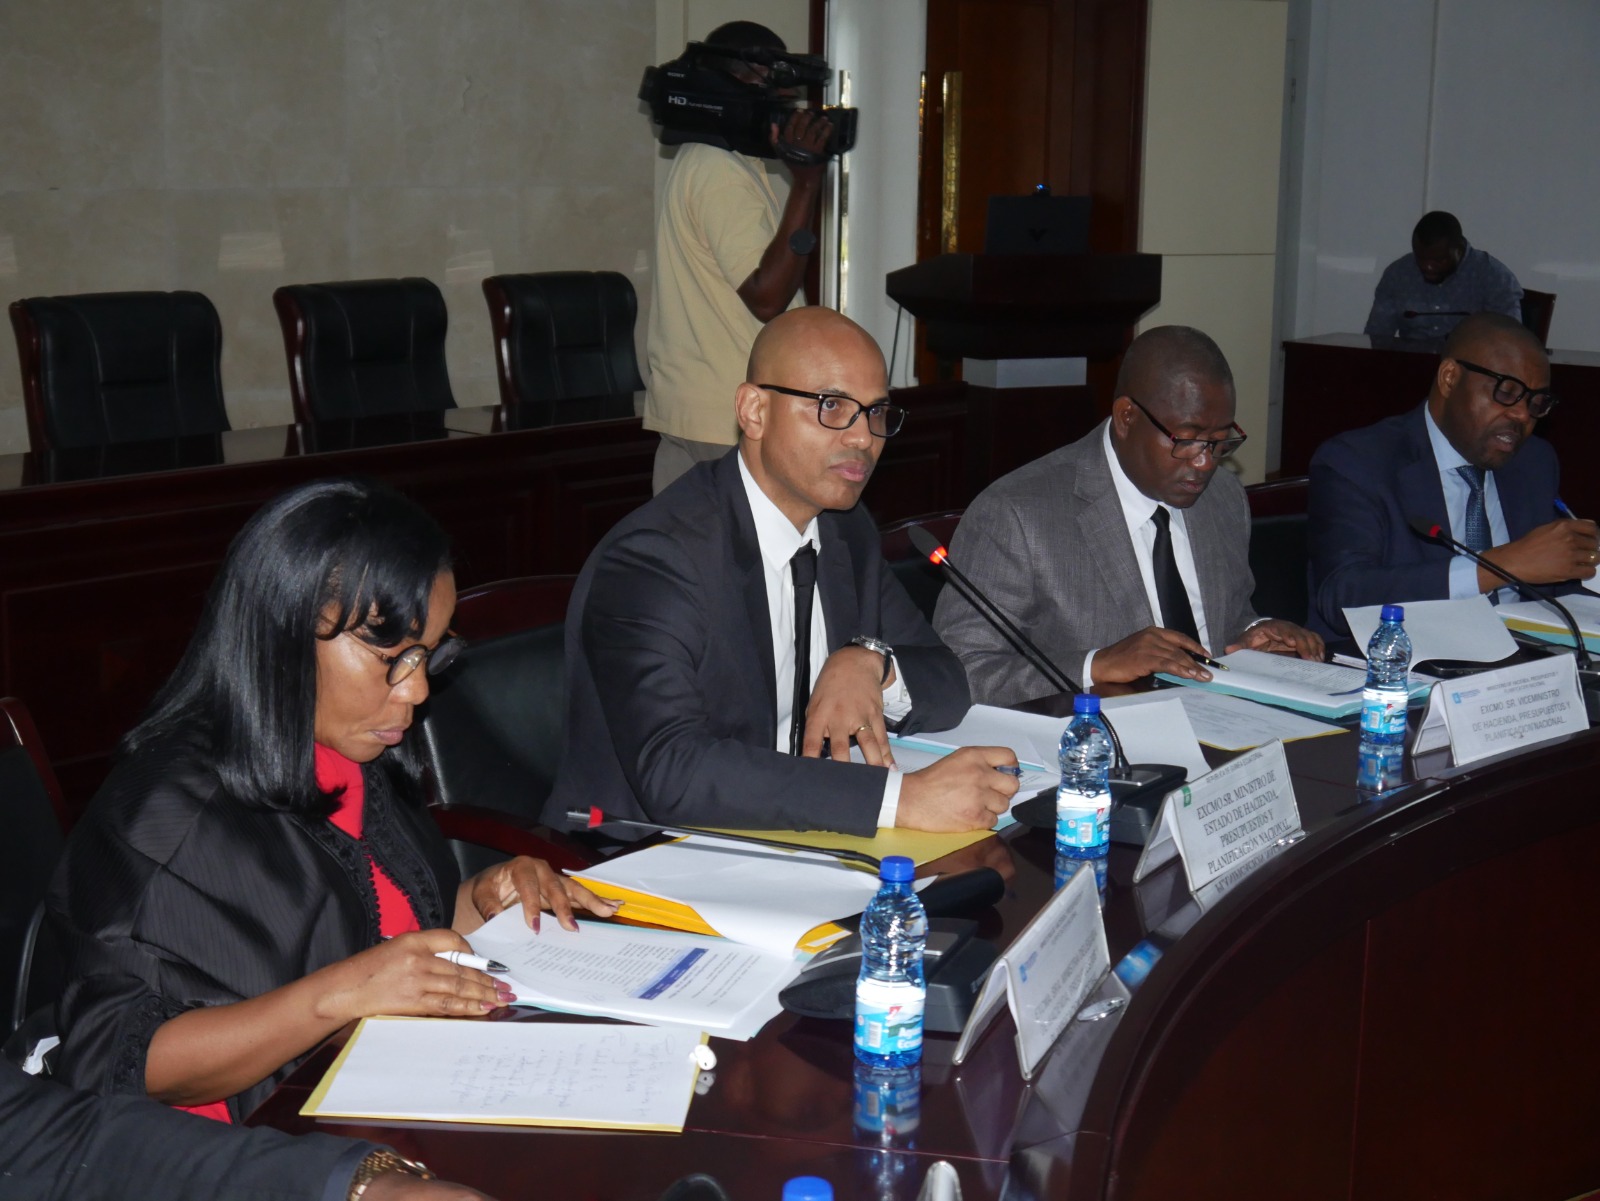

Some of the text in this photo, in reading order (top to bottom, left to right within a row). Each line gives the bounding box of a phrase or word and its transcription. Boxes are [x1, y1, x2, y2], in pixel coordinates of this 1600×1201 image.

[668, 95, 687, 106] HD
[1518, 688, 1560, 706] VICEMINISTRO
[1472, 721, 1482, 732] DE
[1518, 703, 1567, 721] PRESUPUESTOS
[1233, 773, 1267, 801] MINISTRO
[1265, 769, 1276, 784] DE
[1203, 810, 1233, 837] ESTADO
[1232, 804, 1244, 821] DE
[1219, 810, 1269, 848] PRESUPUESTOS
